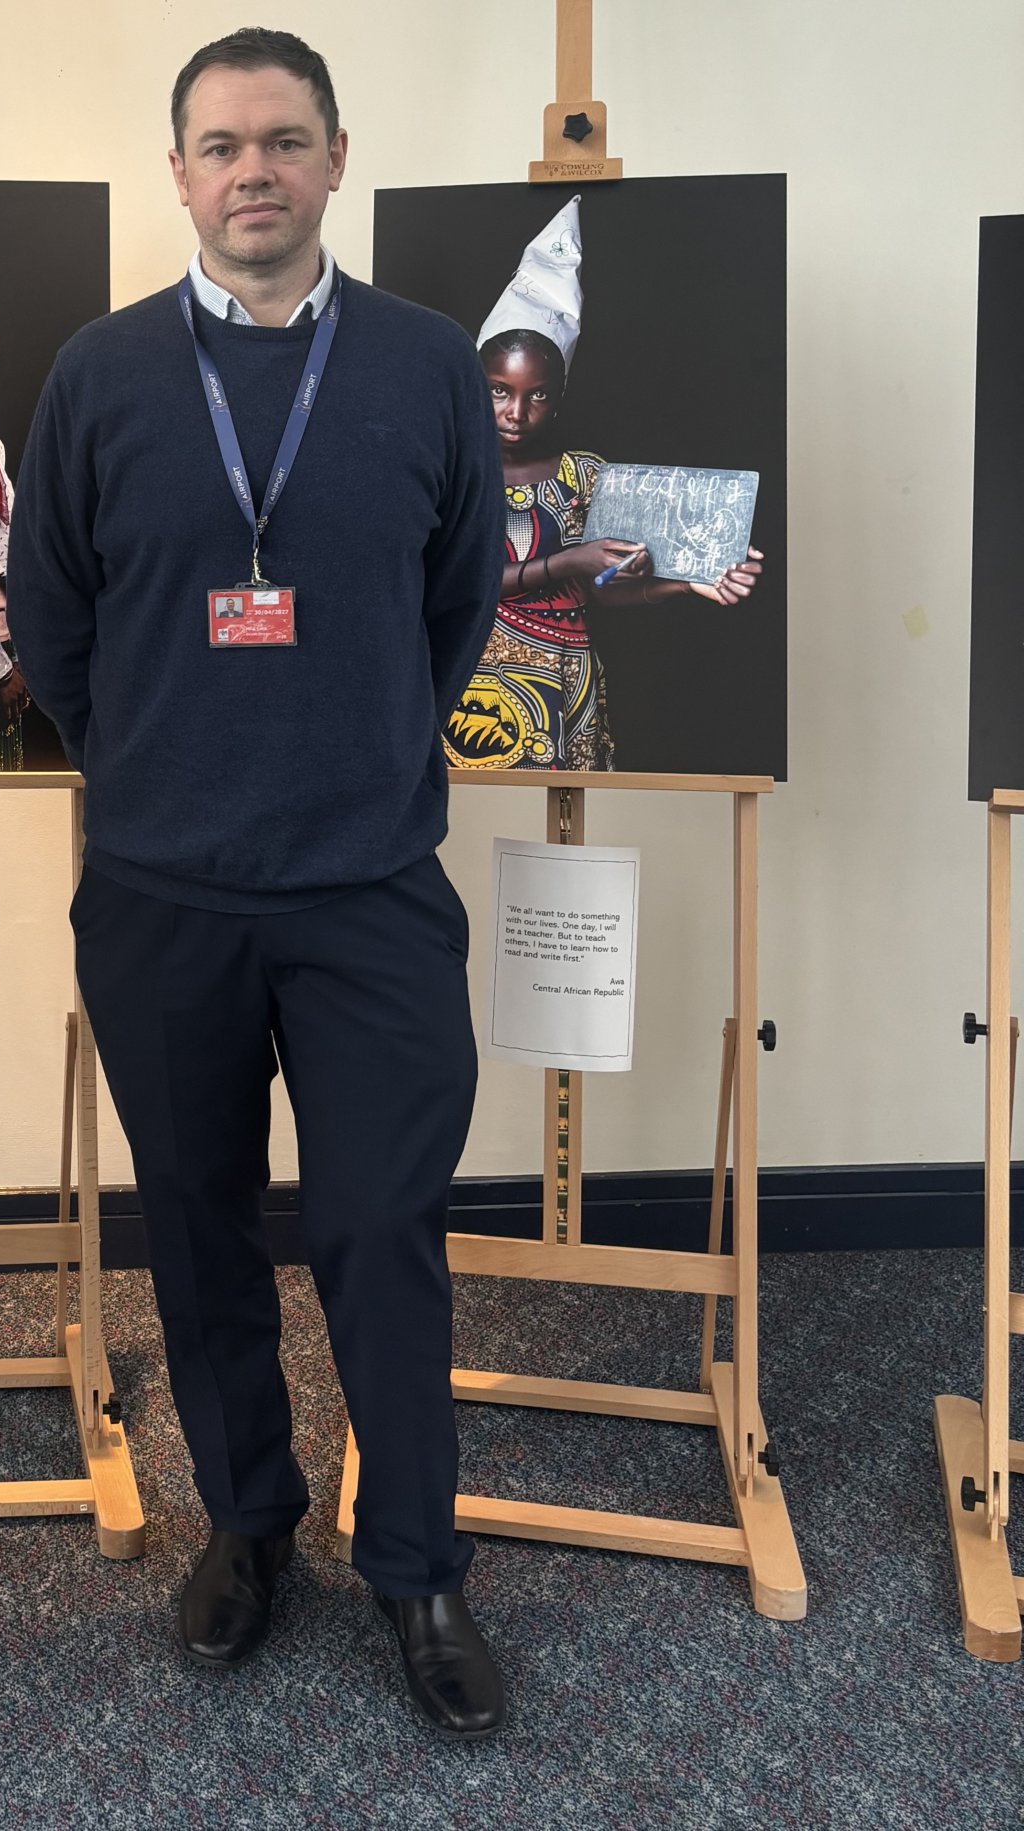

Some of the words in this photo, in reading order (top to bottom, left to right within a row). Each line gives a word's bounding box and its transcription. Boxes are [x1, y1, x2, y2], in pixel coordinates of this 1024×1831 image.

[208, 373, 222, 404] AIRPORT
[302, 373, 317, 406] AIRPORT
[232, 466, 248, 499] AIRPORT
[270, 466, 286, 502] AIRPORT
[581, 914, 620, 922] something
[581, 923, 597, 932] day,
[532, 984, 562, 992] Central
[593, 989, 624, 998] Republic
